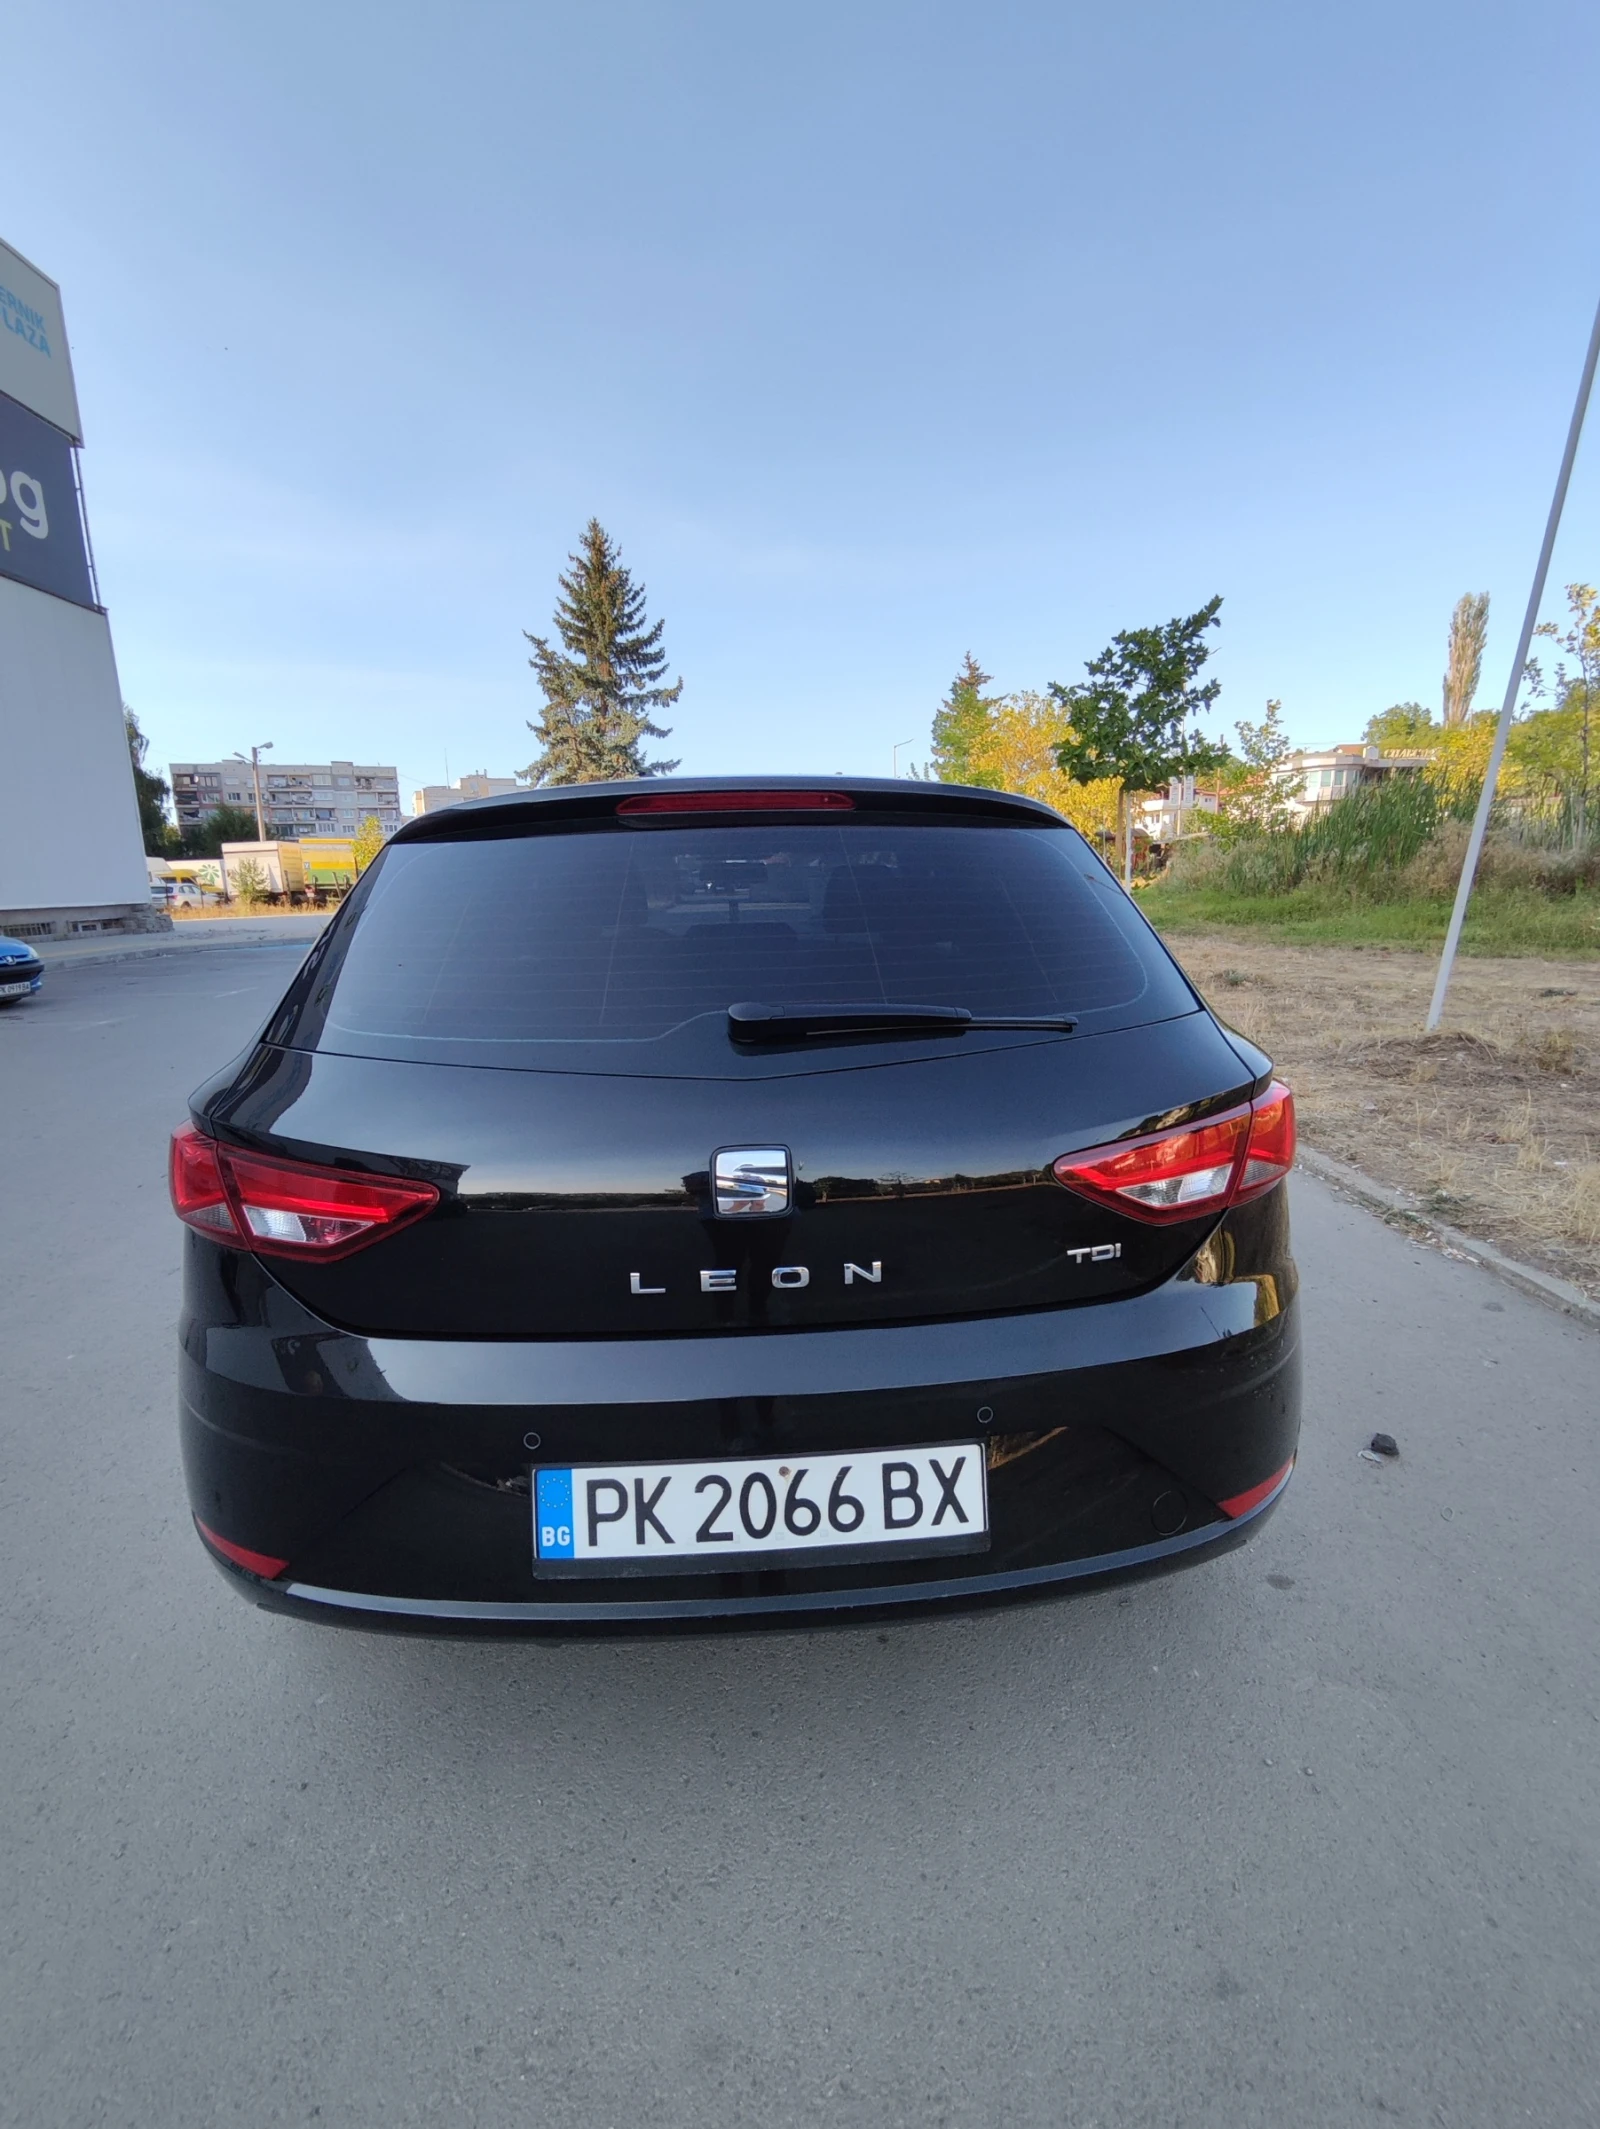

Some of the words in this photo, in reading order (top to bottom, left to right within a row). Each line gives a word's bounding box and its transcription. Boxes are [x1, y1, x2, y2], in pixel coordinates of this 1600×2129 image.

[0, 306, 51, 359] LAZA
[1067, 1243, 1121, 1263] TDI
[630, 1261, 882, 1294] LEON
[586, 1475, 676, 1547] PK
[694, 1465, 865, 1542] 2066
[881, 1456, 970, 1530] BX
[541, 1526, 570, 1546] BG
